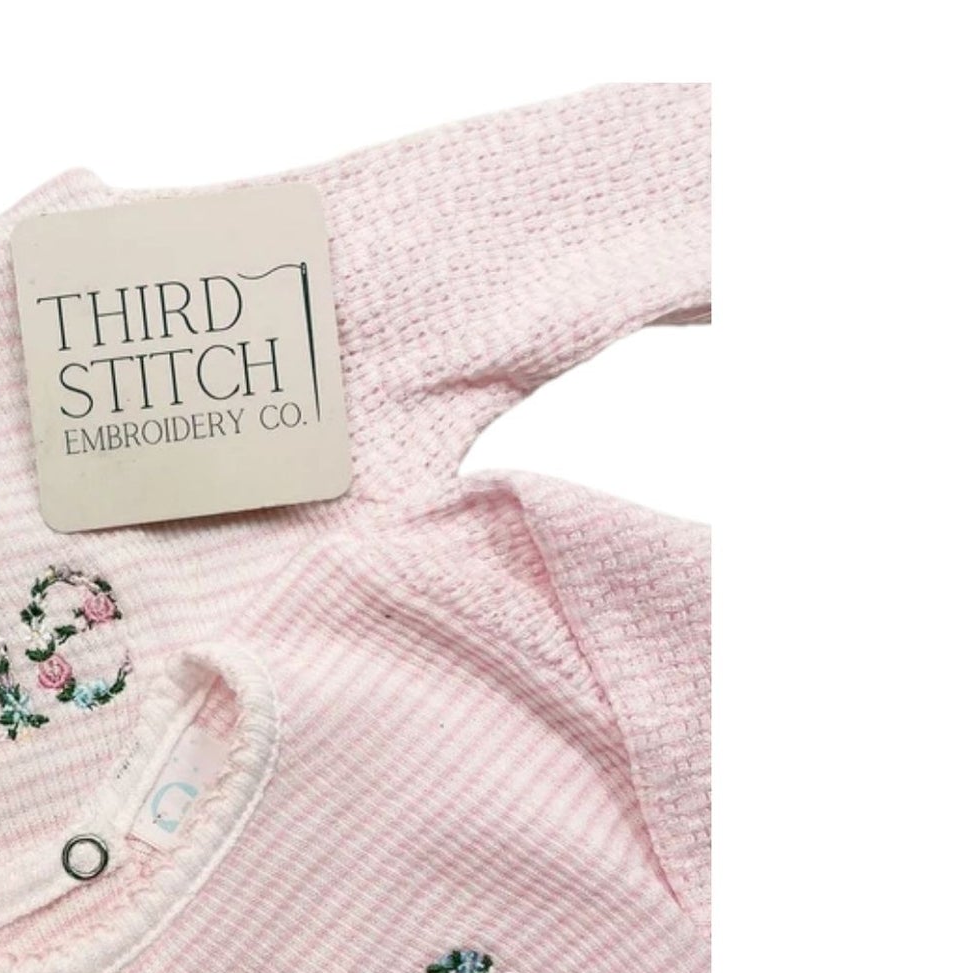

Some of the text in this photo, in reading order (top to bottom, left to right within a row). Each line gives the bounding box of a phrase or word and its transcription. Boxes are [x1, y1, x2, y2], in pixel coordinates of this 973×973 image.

[36, 275, 243, 351] THIRD
[58, 337, 284, 418] STITCH
[63, 402, 308, 455] EMBROIDERY CO.
